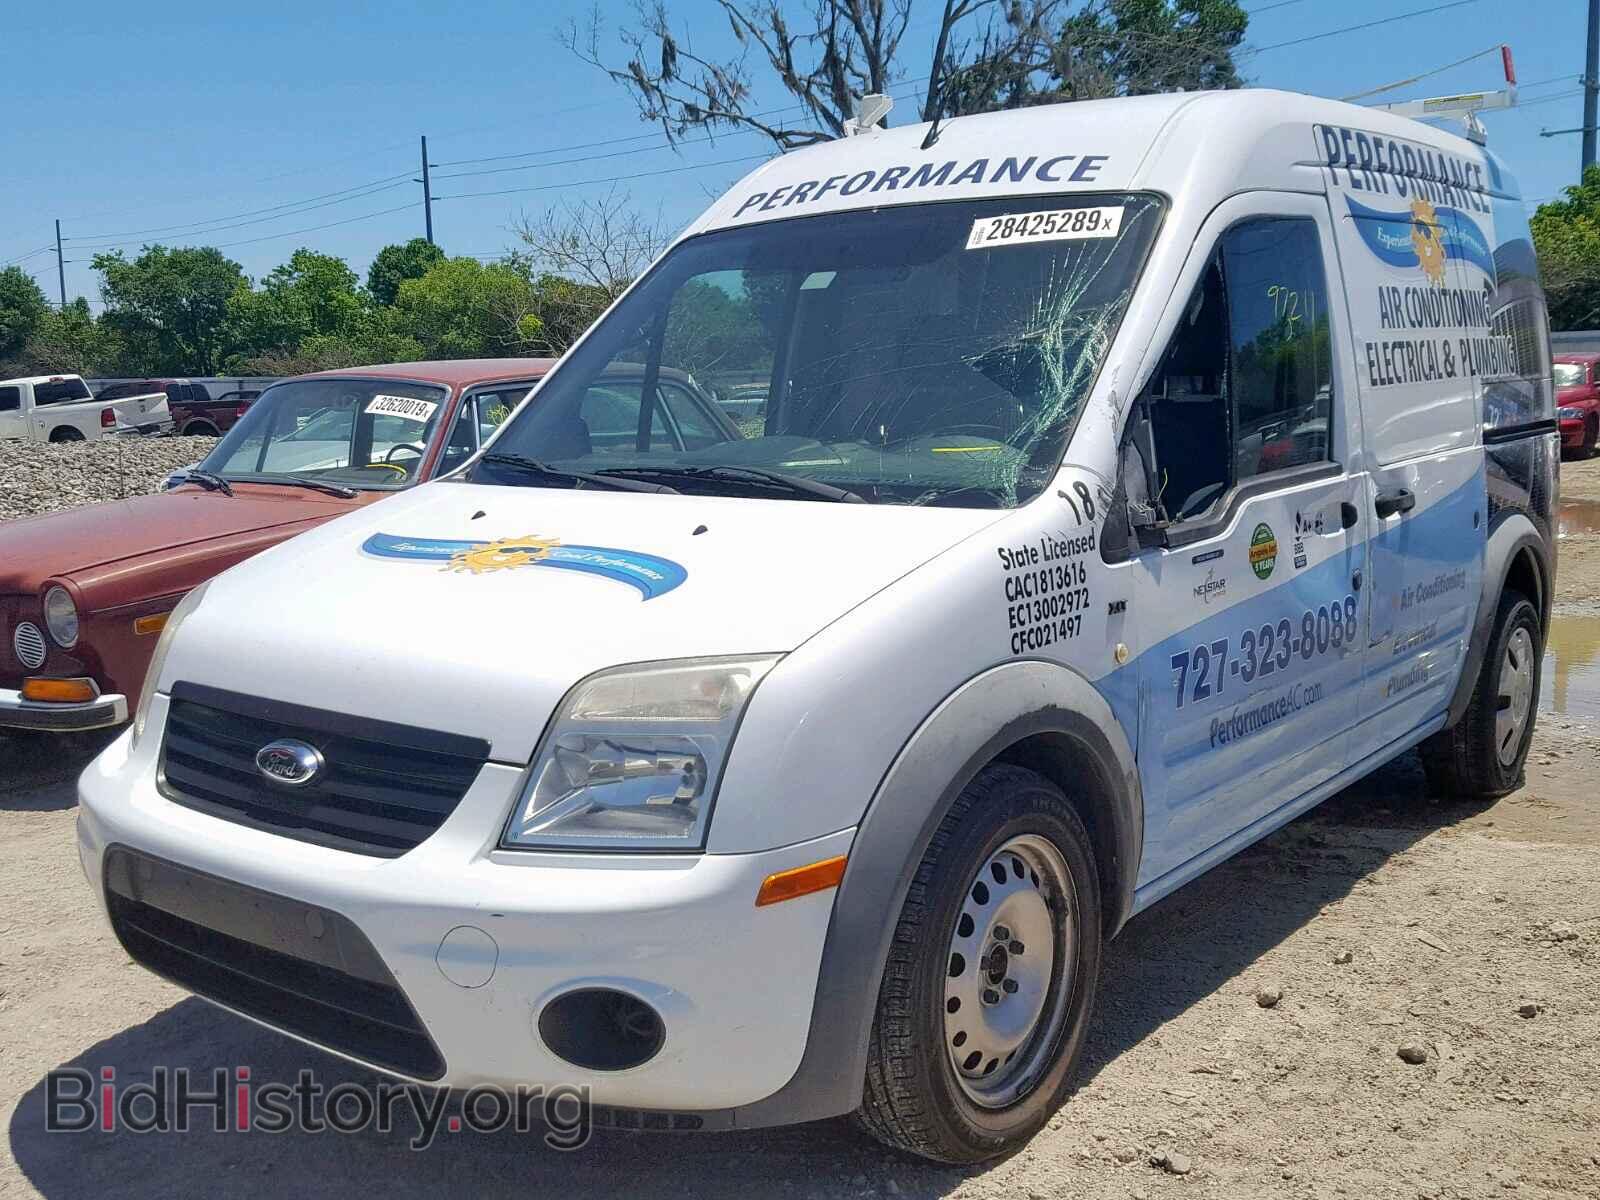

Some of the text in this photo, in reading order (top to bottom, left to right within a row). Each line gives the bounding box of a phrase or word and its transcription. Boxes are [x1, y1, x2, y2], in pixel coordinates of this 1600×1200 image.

[732, 155, 1109, 218] PERFORMANCE
[1321, 126, 1490, 213] PERFORMANCE
[1378, 286, 1493, 329] AIR CONDITIONING
[1366, 335, 1520, 386] ELECTRICAL & PLUMBING
[1057, 481, 1096, 525] 18
[998, 527, 1096, 570] State Licensed
[1005, 560, 1087, 602] CAC1813616
[1008, 587, 1090, 629] EC13002972
[1011, 614, 1082, 655] CFC021497
[1170, 594, 1358, 711] 727-323-8088
